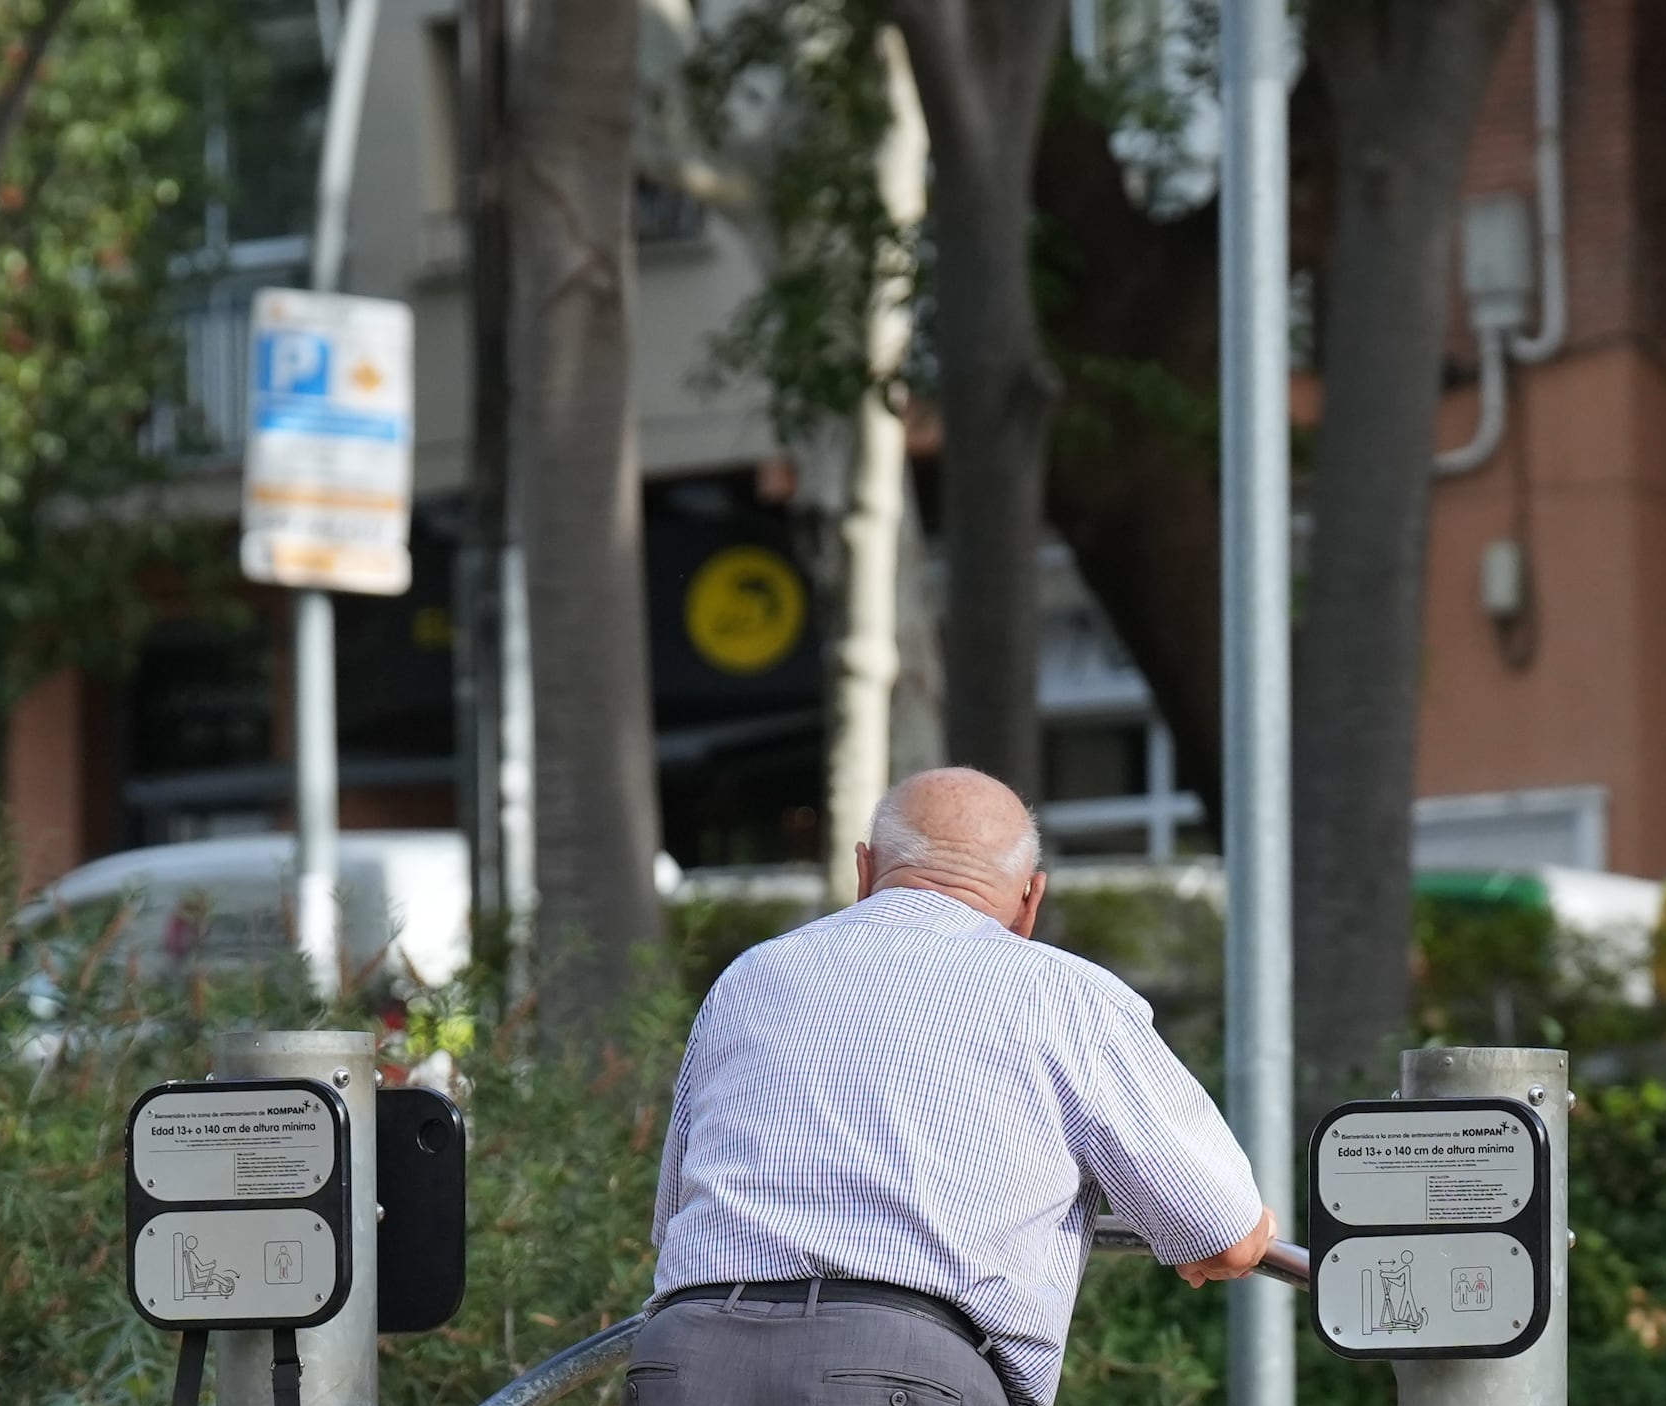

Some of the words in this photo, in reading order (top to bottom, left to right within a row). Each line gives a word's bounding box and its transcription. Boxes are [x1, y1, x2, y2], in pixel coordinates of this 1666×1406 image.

[267, 1107, 305, 1115] KOMPAN
[151, 1125, 174, 1136] Edad
[177, 1125, 193, 1135] 13+
[204, 1124, 220, 1134] 140
[222, 1126, 236, 1134] cm
[239, 1123, 250, 1133] de
[253, 1122, 279, 1132] altura
[282, 1121, 316, 1131] mínima
[1462, 1128, 1502, 1137] KOMPAN
[1338, 1147, 1362, 1157] Edad
[1365, 1147, 1382, 1156] 13+
[1394, 1146, 1412, 1156] 140
[1431, 1145, 1444, 1155] de
[1446, 1144, 1475, 1154] altura
[1478, 1143, 1514, 1154] mínima
